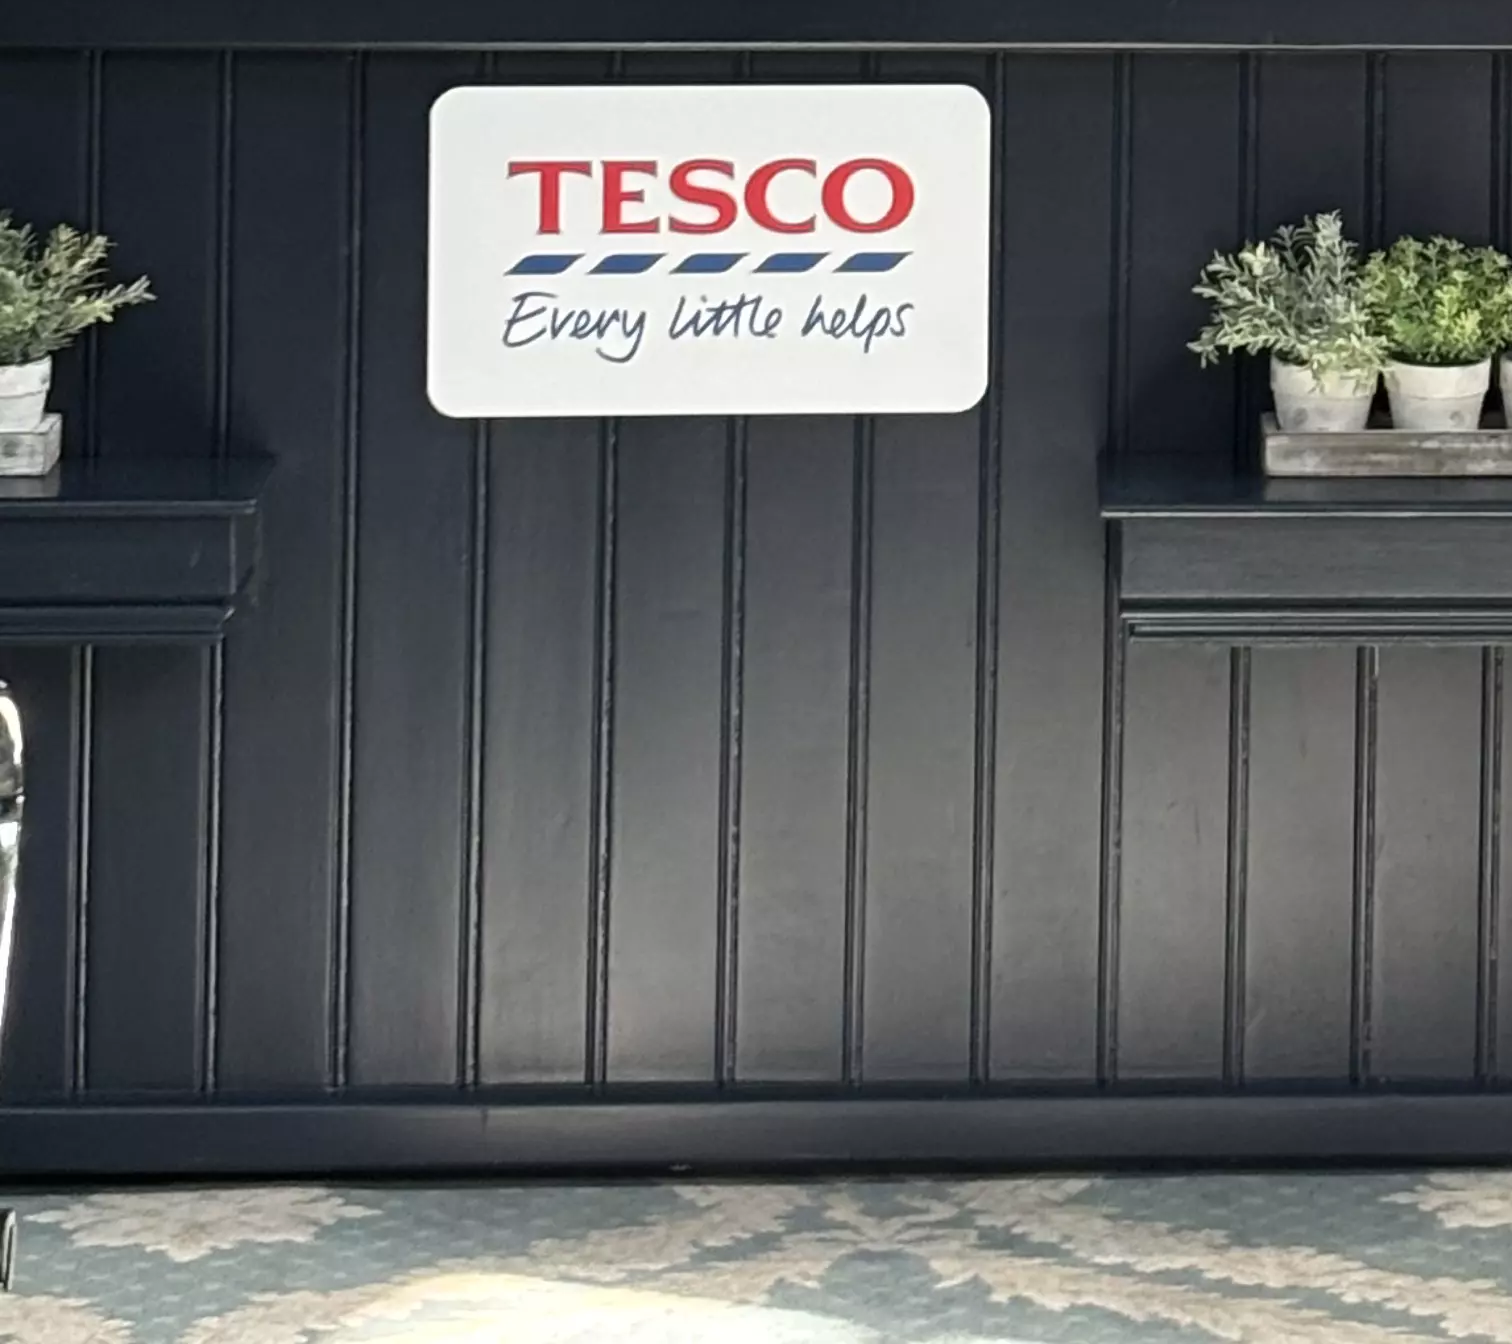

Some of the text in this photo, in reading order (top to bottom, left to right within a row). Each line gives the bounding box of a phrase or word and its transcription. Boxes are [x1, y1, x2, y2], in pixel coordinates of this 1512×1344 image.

[507, 157, 915, 235] TESCO
[502, 291, 914, 363] Every little helps
